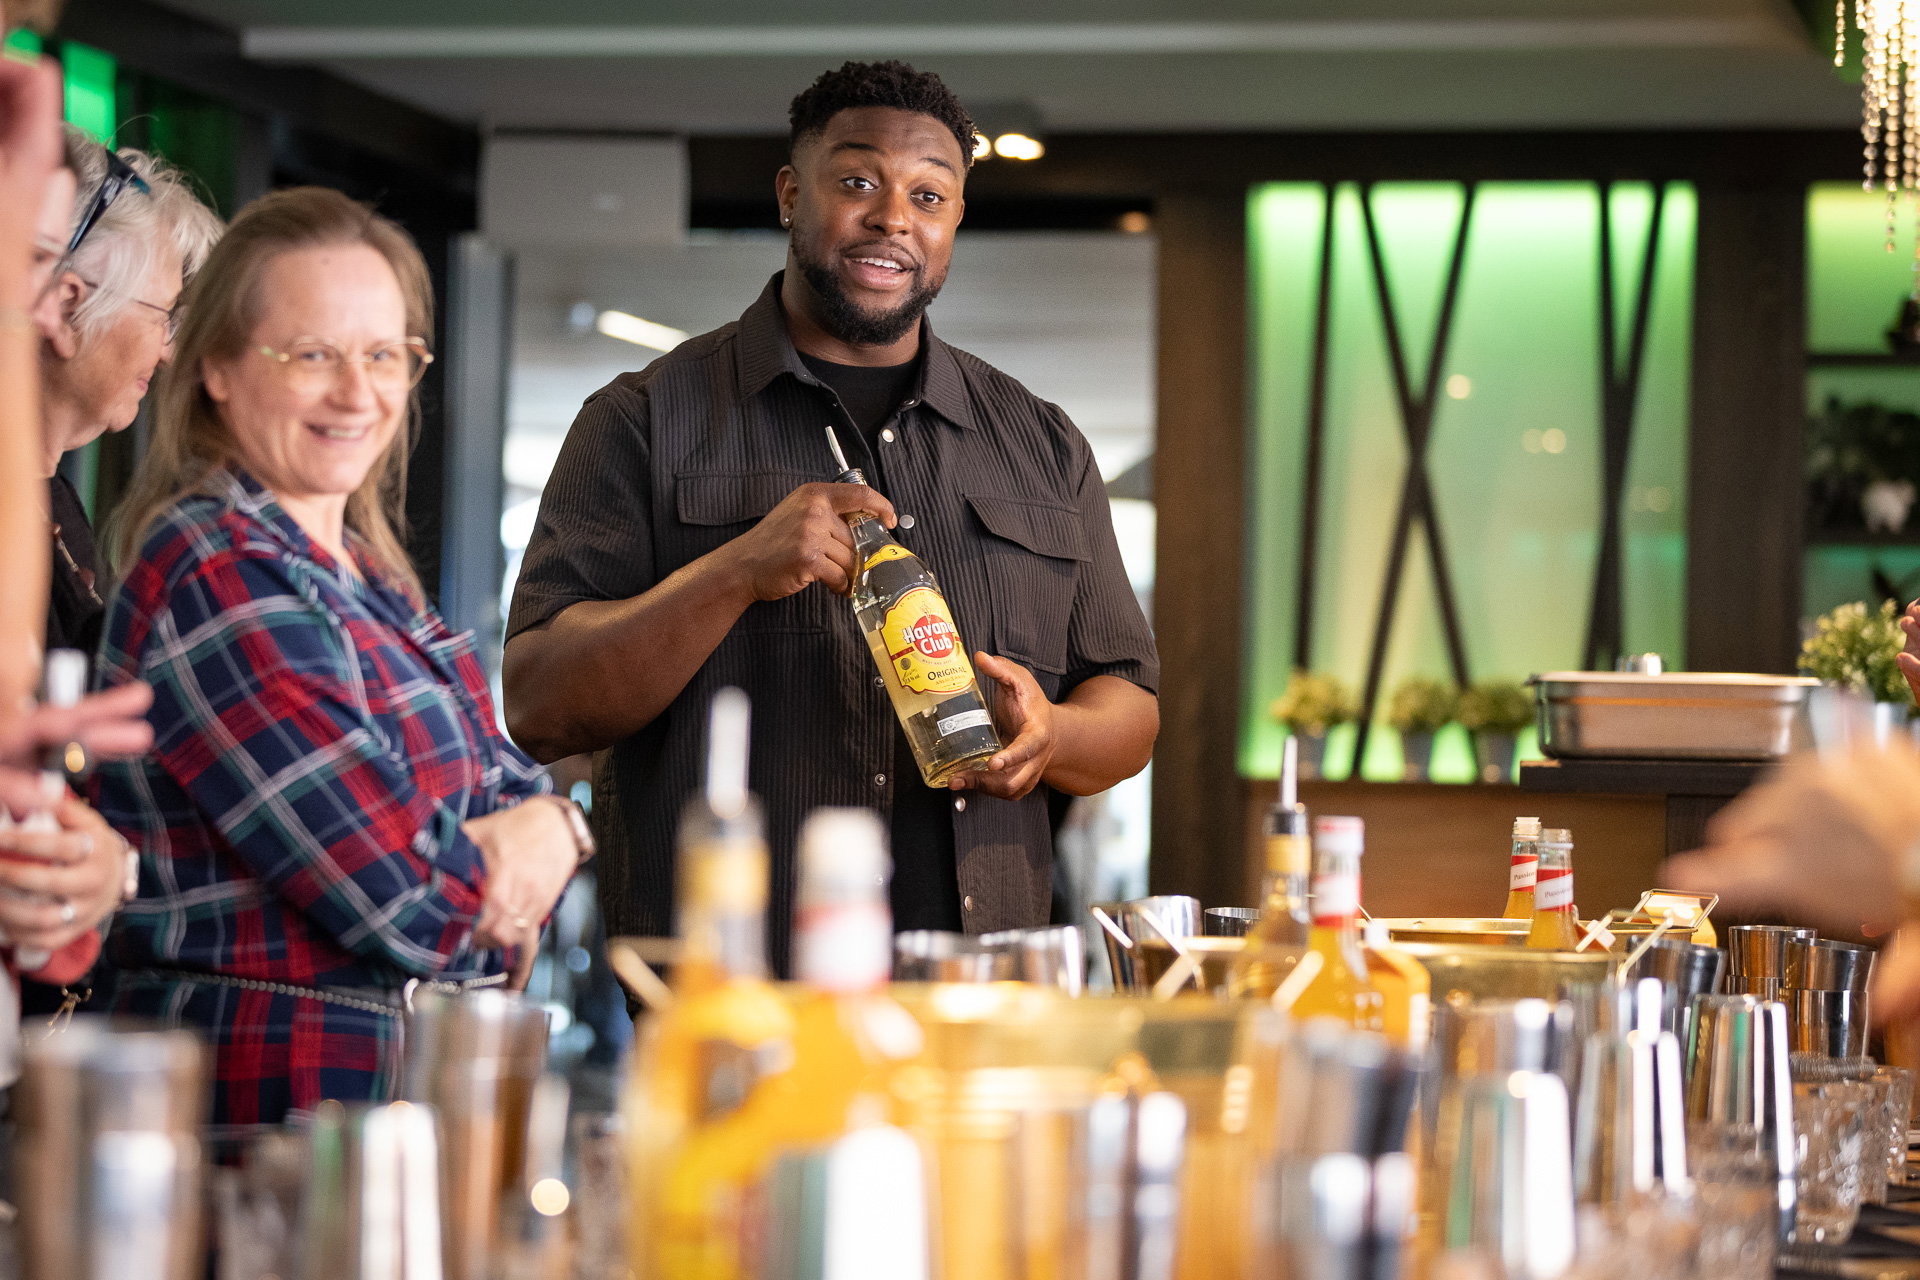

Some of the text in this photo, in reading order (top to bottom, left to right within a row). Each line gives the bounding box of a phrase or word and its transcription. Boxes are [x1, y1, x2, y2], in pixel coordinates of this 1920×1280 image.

[889, 548, 898, 556] 3
[902, 621, 955, 644] Havana
[920, 634, 953, 654] Club
[927, 666, 967, 681] ORIGINAL
